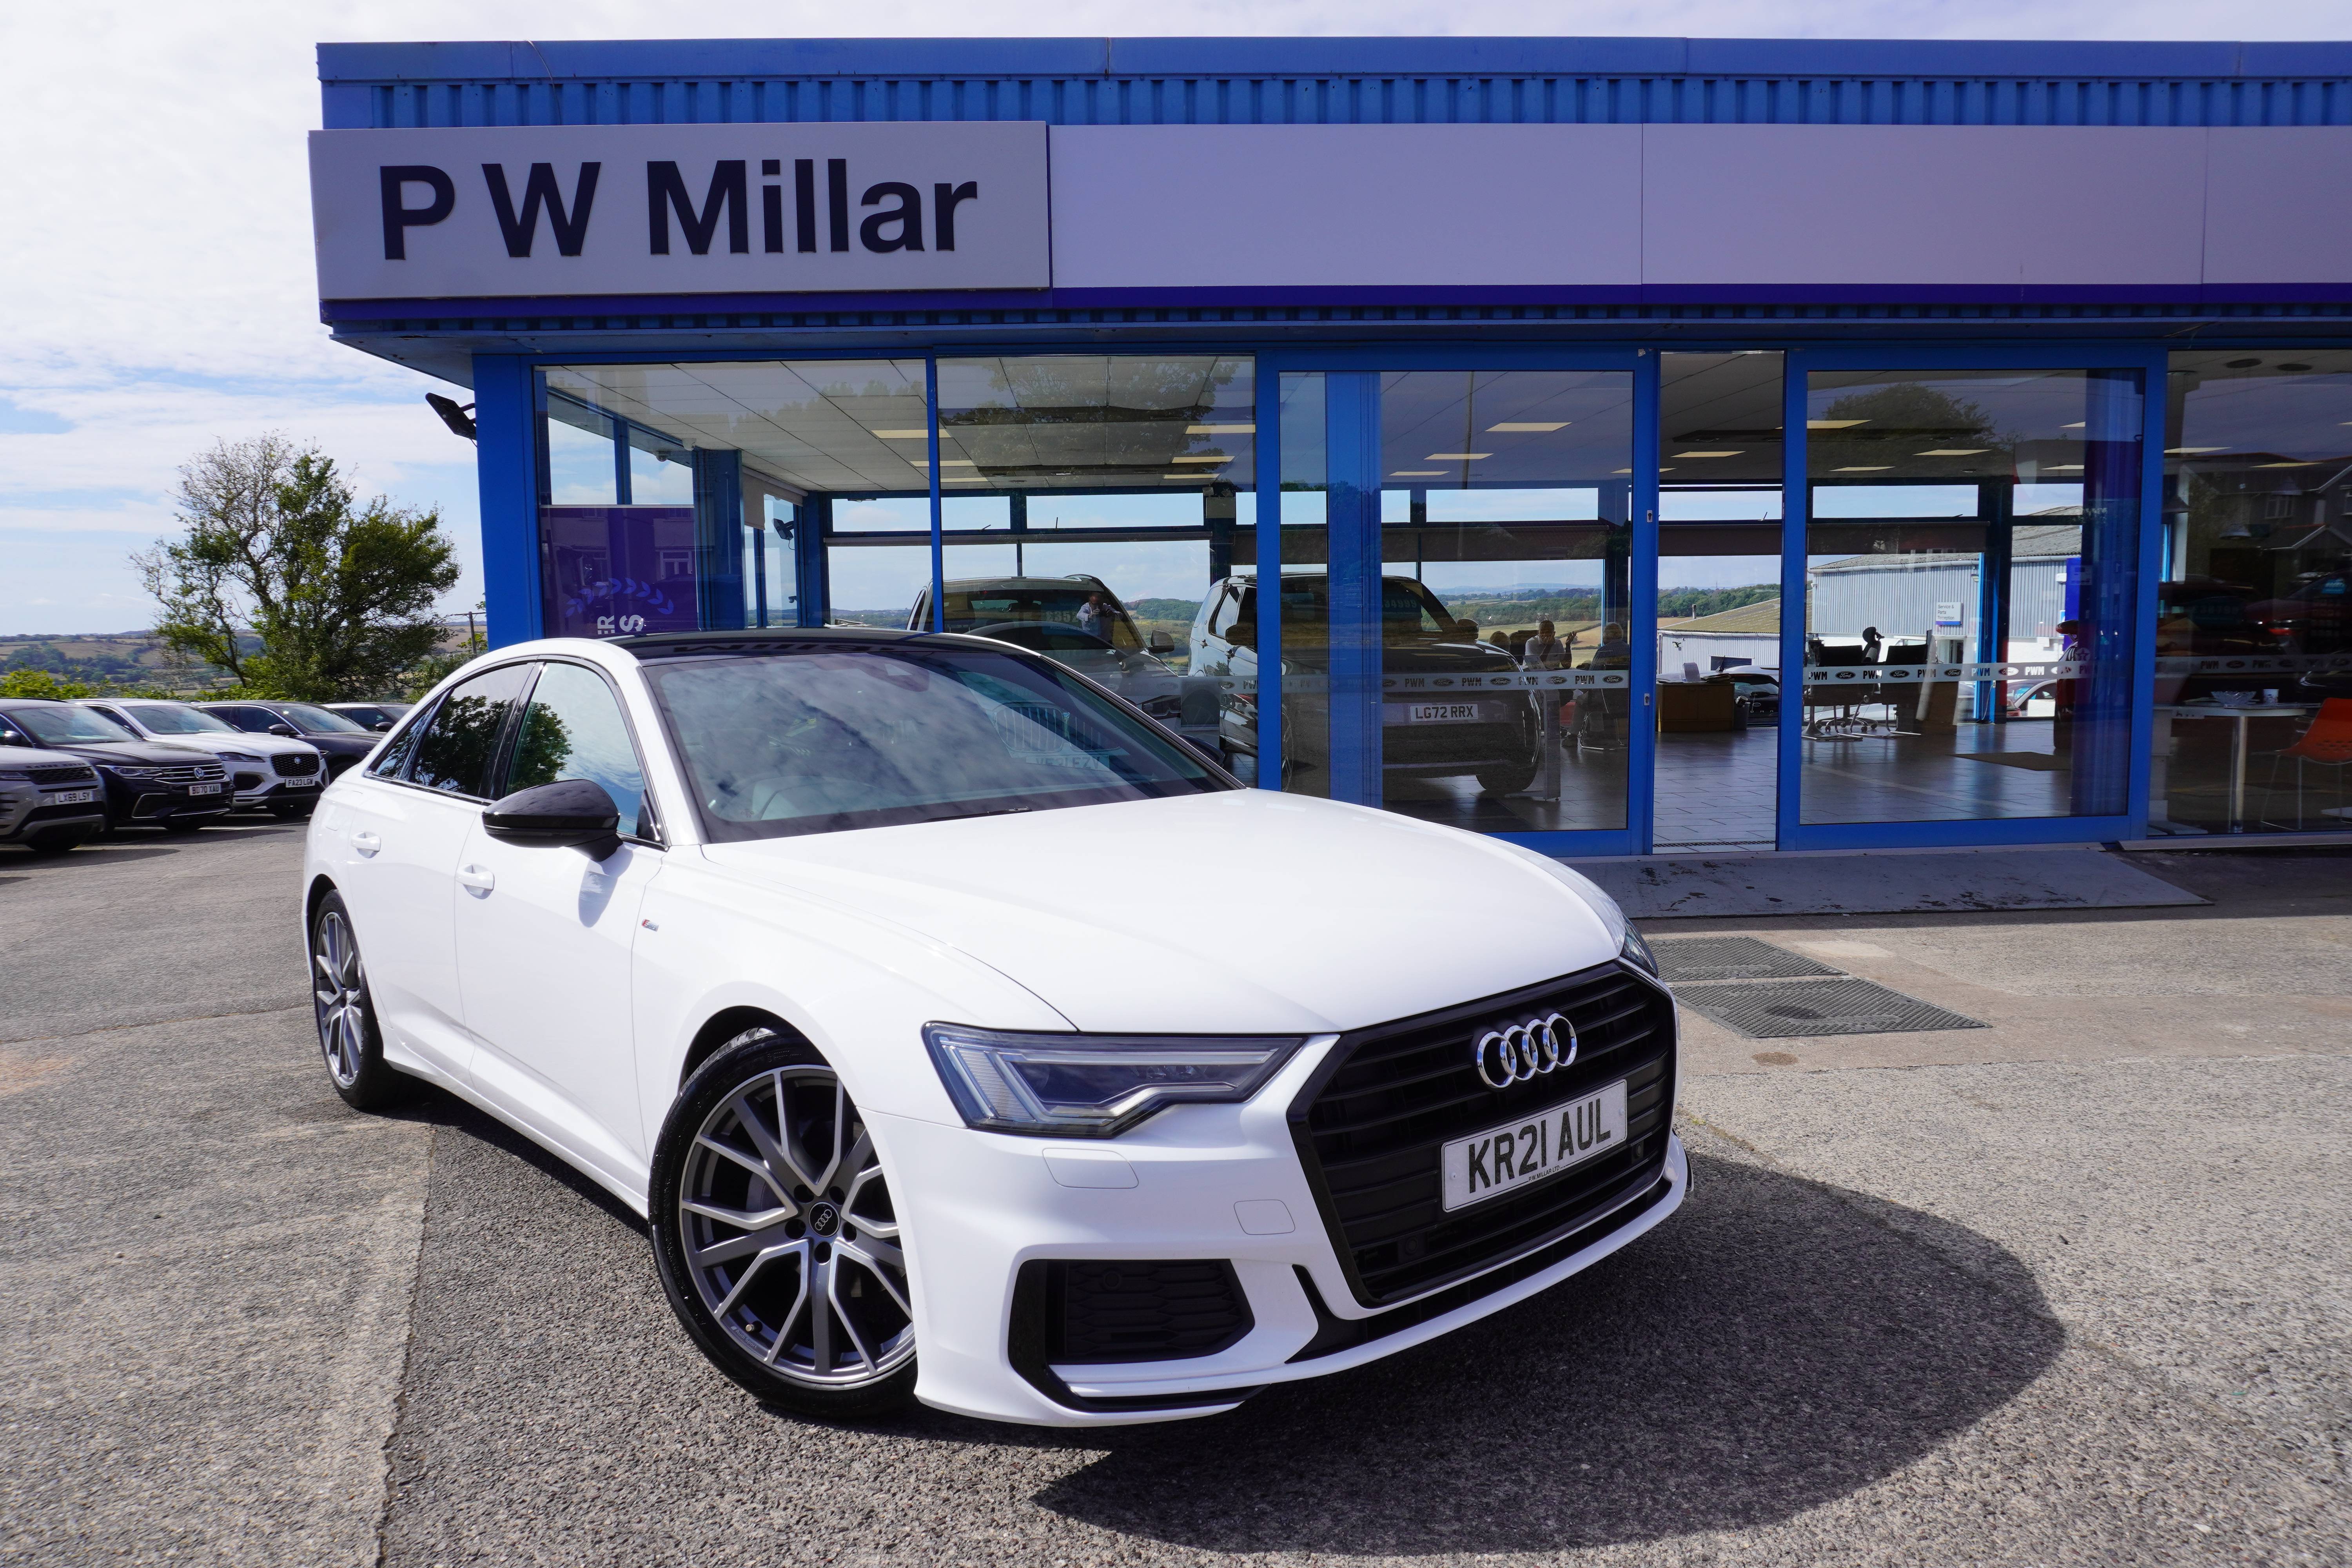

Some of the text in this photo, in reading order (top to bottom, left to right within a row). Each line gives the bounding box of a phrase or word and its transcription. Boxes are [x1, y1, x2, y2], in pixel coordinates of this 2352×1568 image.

[380, 158, 978, 261] P W Millar
[1382, 599, 1417, 608] 34999
[1808, 671, 1828, 681] PWM
[1971, 668, 1990, 676] PWM
[2025, 666, 2044, 675] PWM
[1243, 680, 1258, 689] PW
[1405, 679, 1425, 687] PWM
[1462, 677, 1482, 686] PWM
[1518, 676, 1539, 685] PWM
[1575, 675, 1595, 684] PWM
[1415, 706, 1474, 719] LG72 RRX
[192, 784, 220, 794] BD70 XAU
[59, 792, 90, 802] LX69 LSY
[1468, 1098, 1611, 1194] KR21 AUL
[736, 1329, 746, 1339] Audi
